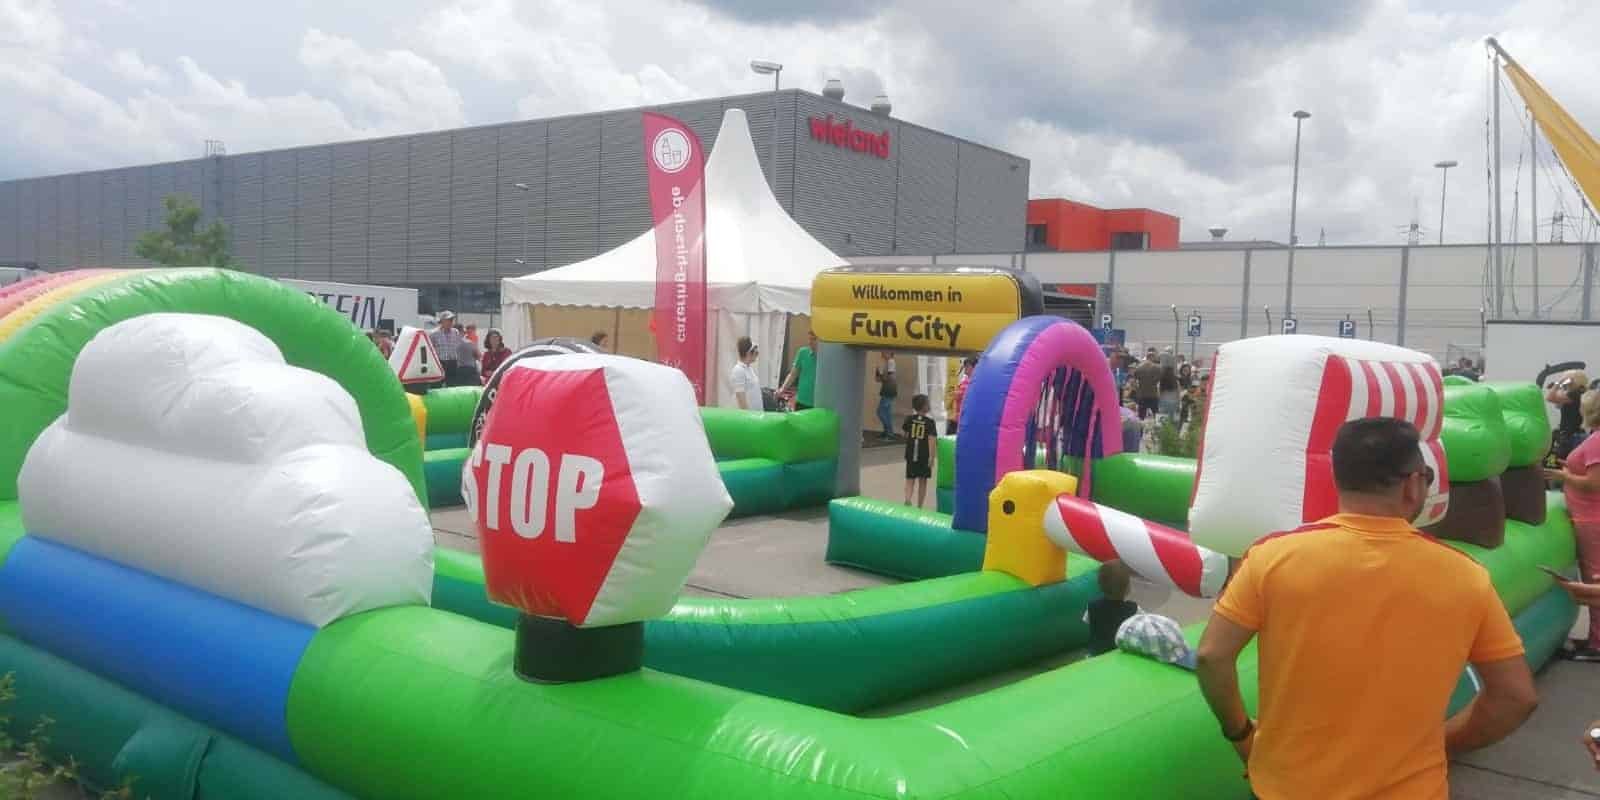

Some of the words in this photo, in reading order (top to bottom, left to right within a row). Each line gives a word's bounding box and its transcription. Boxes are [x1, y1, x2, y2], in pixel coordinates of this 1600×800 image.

[808, 112, 890, 160] wieland
[852, 284, 943, 302] Willkommen
[947, 285, 962, 302] in
[851, 312, 898, 338] Fun
[905, 315, 961, 347] City
[1102, 315, 1112, 329] P
[1189, 316, 1200, 331] P
[1283, 319, 1296, 335] P
[1343, 321, 1353, 336] P
[912, 423, 925, 439] 10
[461, 439, 605, 543] STOP
